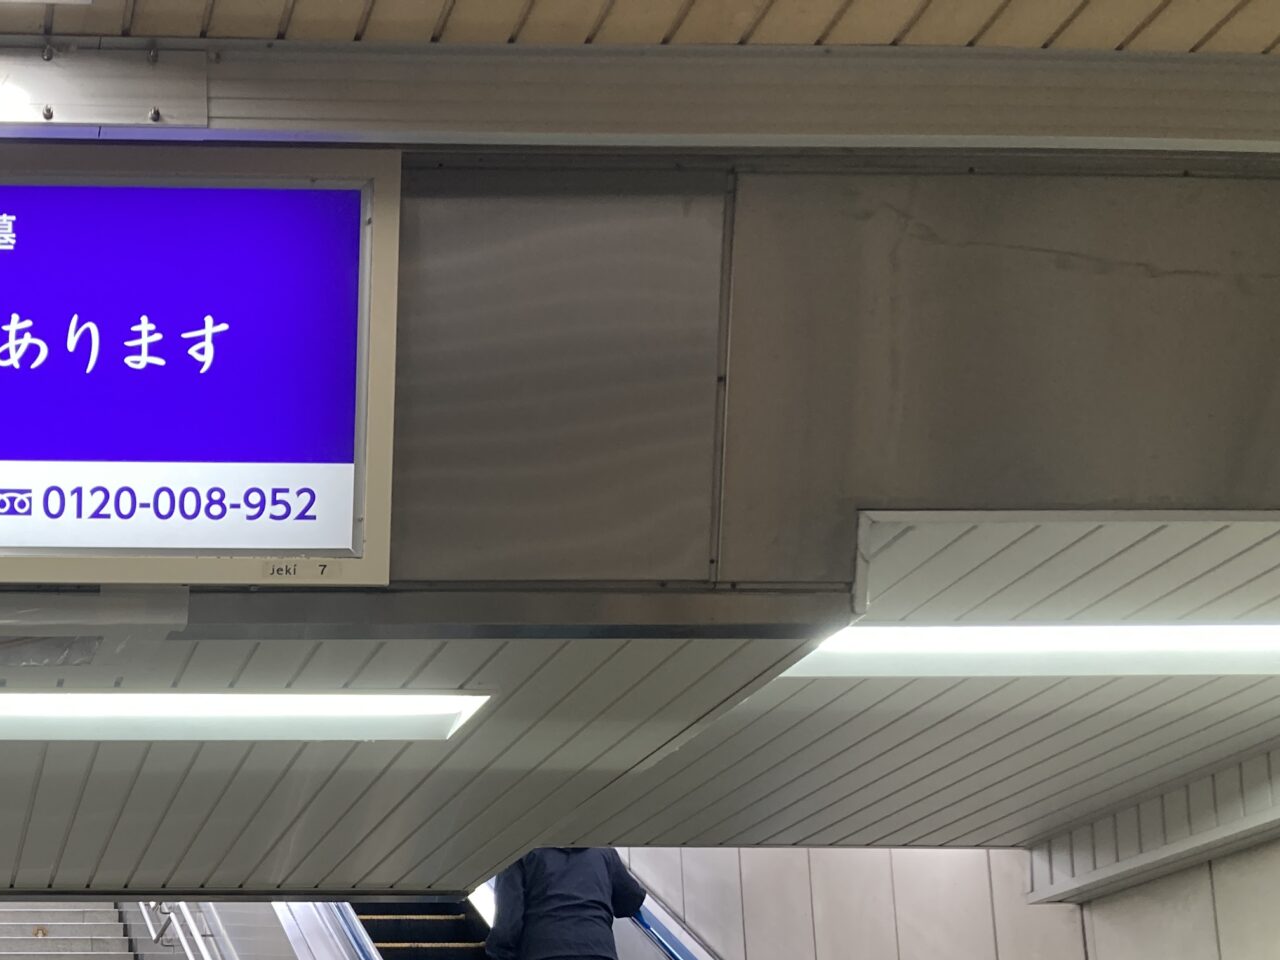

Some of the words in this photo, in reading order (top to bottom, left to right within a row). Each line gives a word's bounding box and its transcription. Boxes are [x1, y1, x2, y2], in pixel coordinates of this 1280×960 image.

[42, 485, 317, 521] 0120-008-952
[270, 564, 297, 576] jeki
[318, 564, 328, 575] 7
